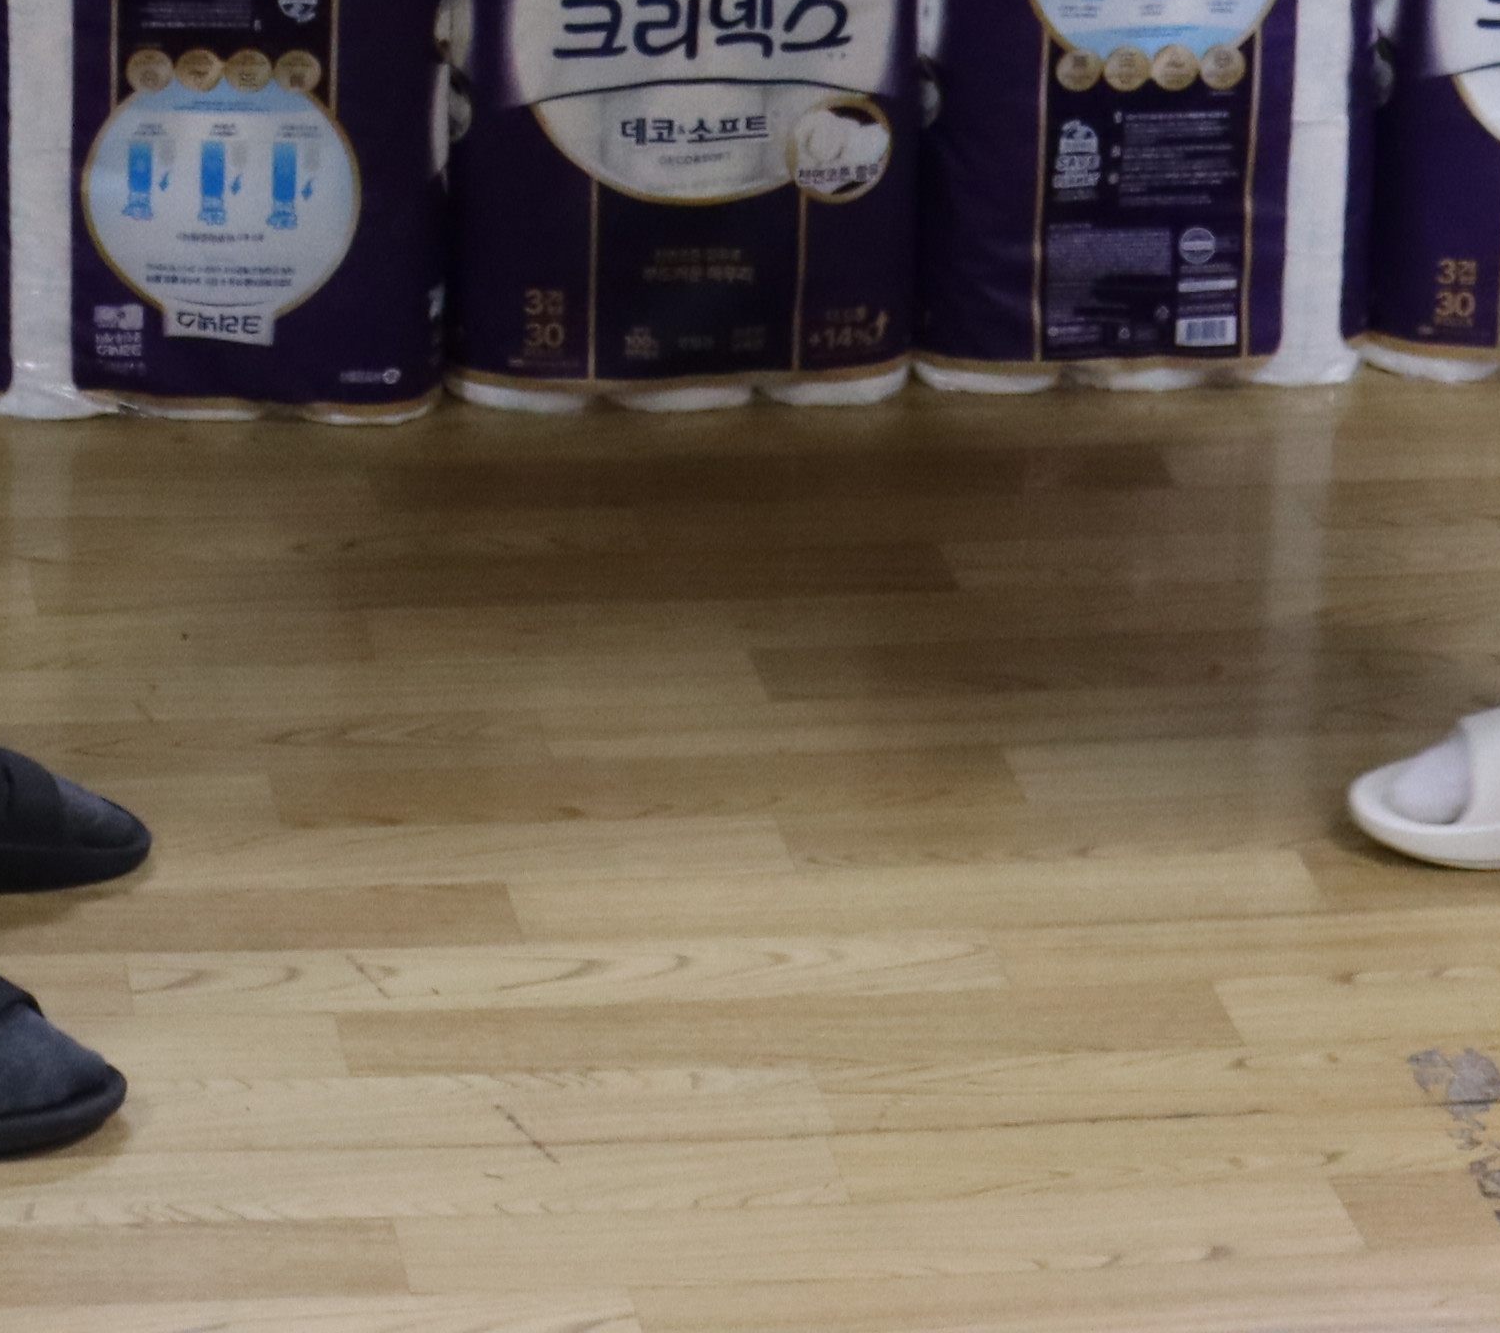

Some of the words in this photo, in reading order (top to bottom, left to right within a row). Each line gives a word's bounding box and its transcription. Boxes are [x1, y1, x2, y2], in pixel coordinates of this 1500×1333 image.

[1434, 290, 1476, 319] 30
[176, 310, 263, 336] 크리넥스
[524, 322, 565, 351] 30
